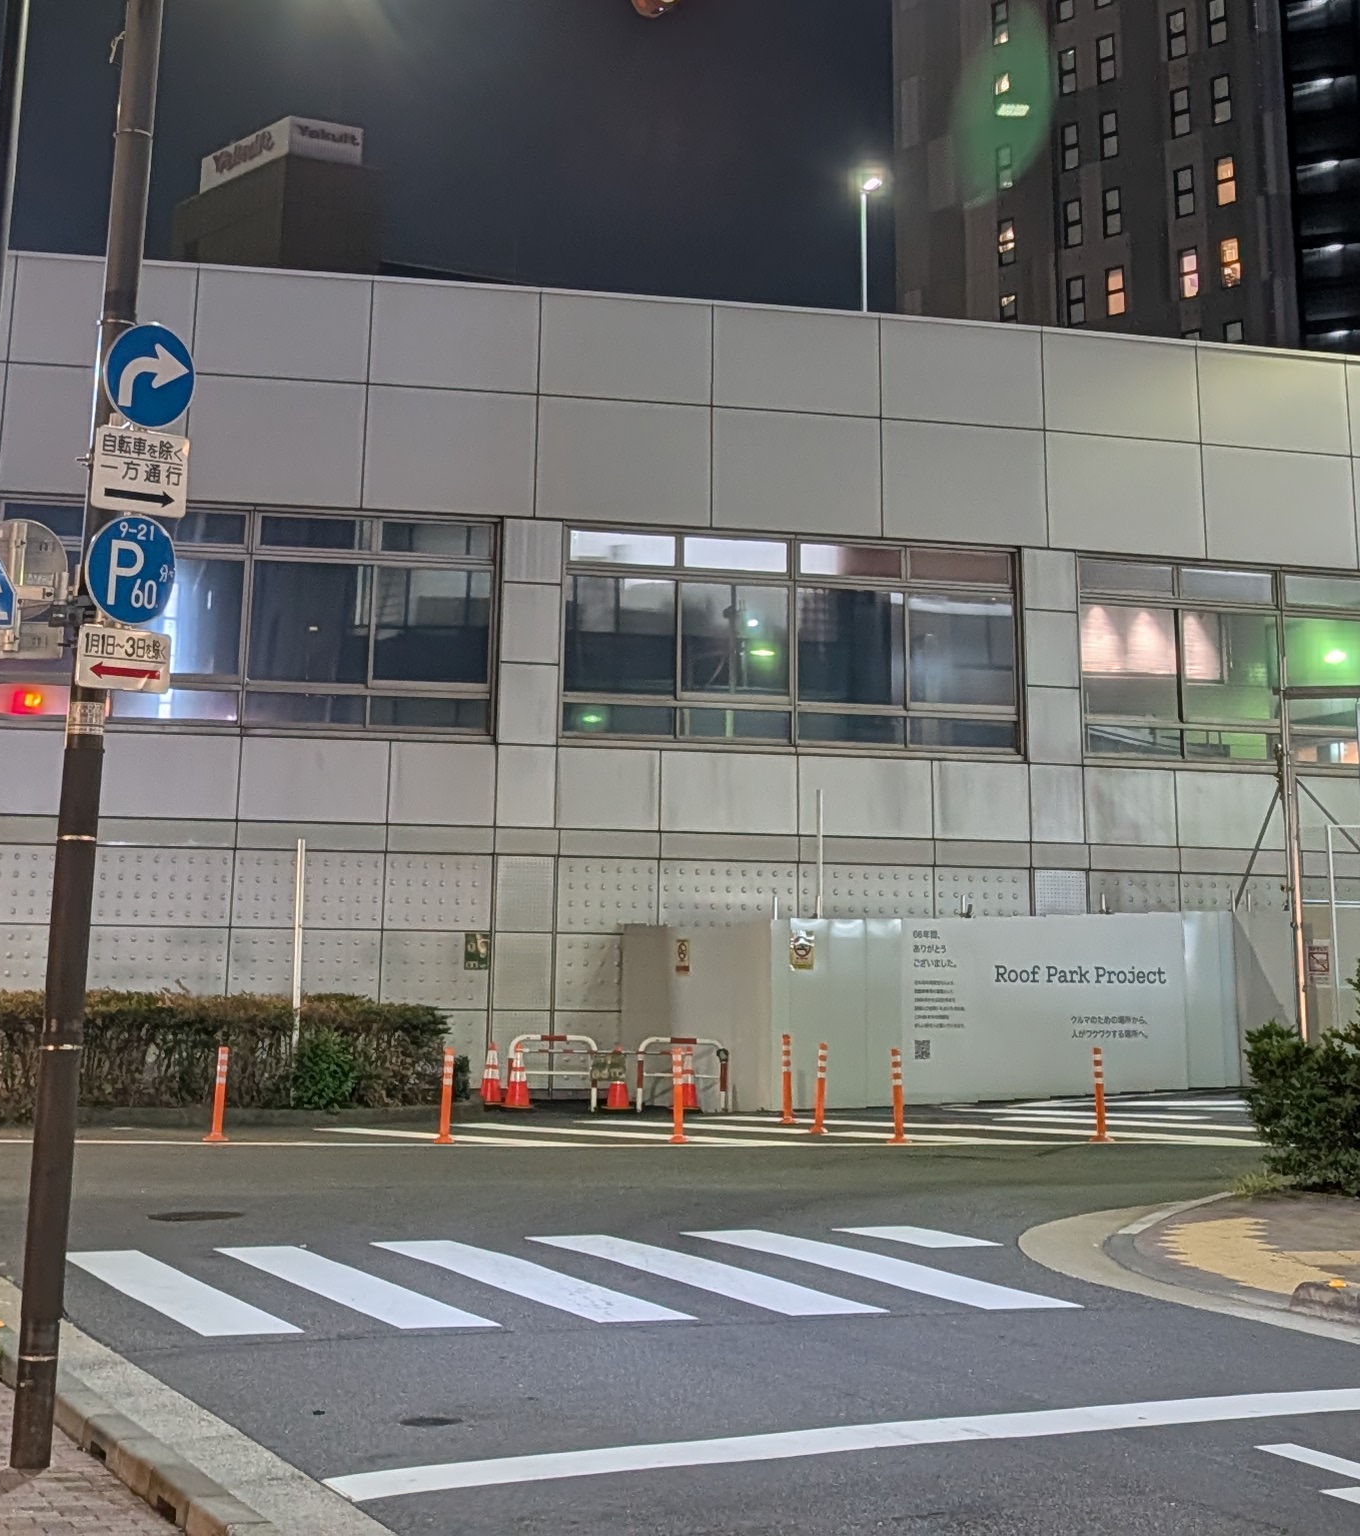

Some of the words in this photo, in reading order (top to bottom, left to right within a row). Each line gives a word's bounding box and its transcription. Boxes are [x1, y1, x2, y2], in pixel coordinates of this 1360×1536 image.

[297, 123, 360, 147] Yakult
[102, 432, 183, 462] 自転車を除く
[100, 461, 183, 486] 一方通行
[119, 521, 155, 542] 9-21
[106, 539, 145, 606] P
[912, 944, 947, 954] ありがとう
[994, 964, 1041, 983] Roof
[1045, 965, 1090, 984] Park
[1094, 965, 1167, 985] Project
